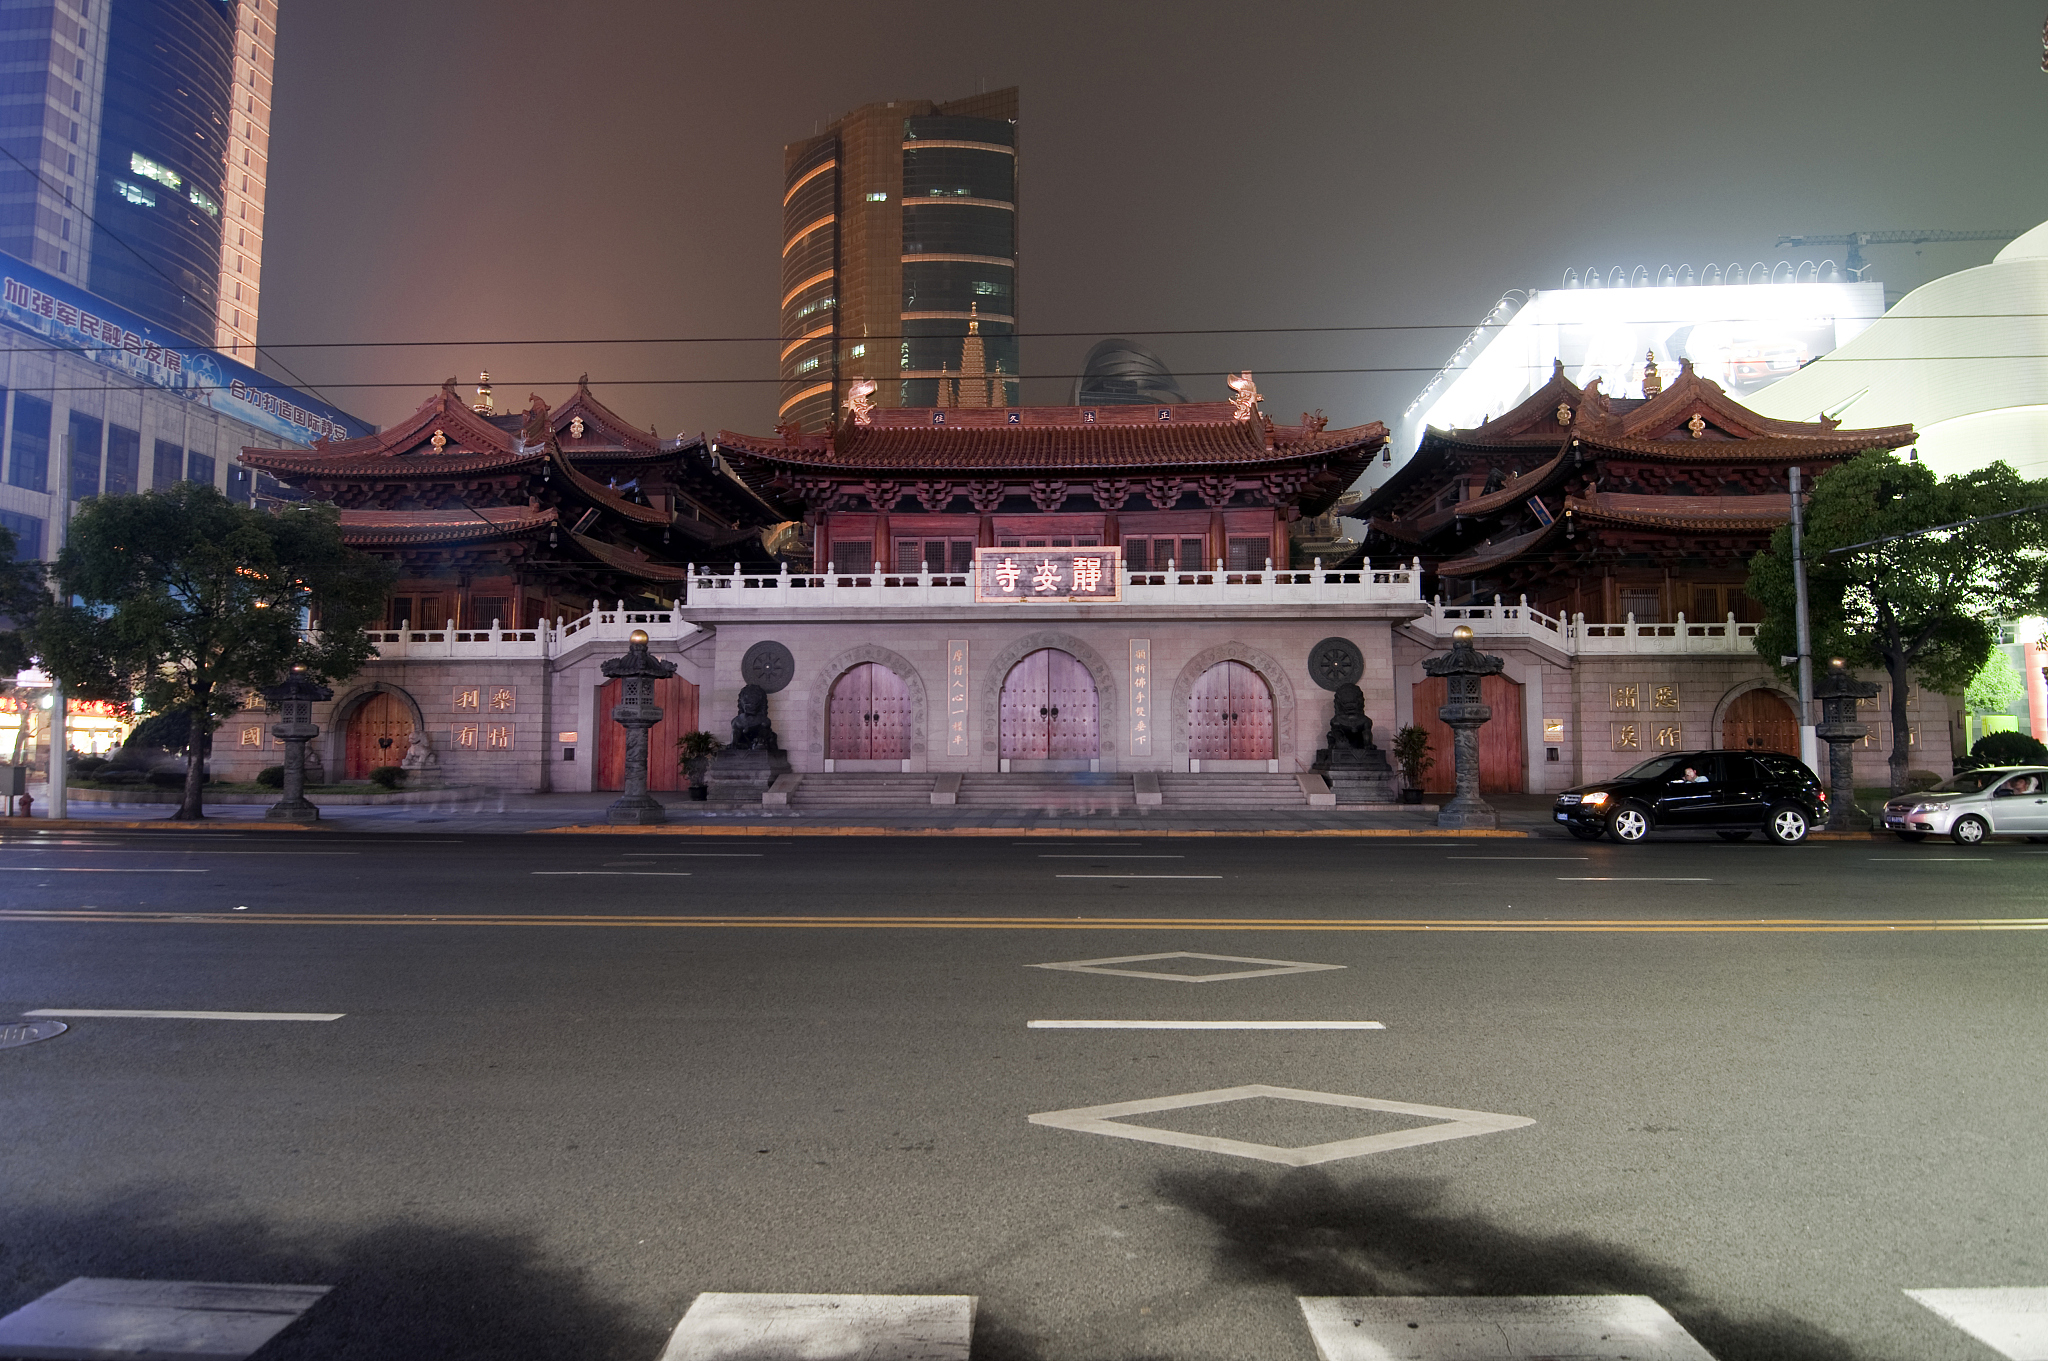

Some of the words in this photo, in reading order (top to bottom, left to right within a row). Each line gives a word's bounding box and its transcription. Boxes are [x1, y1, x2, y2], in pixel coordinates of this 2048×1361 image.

[4, 277, 182, 374] 加强军民融合发展
[230, 378, 347, 442] 合力打造国际静安
